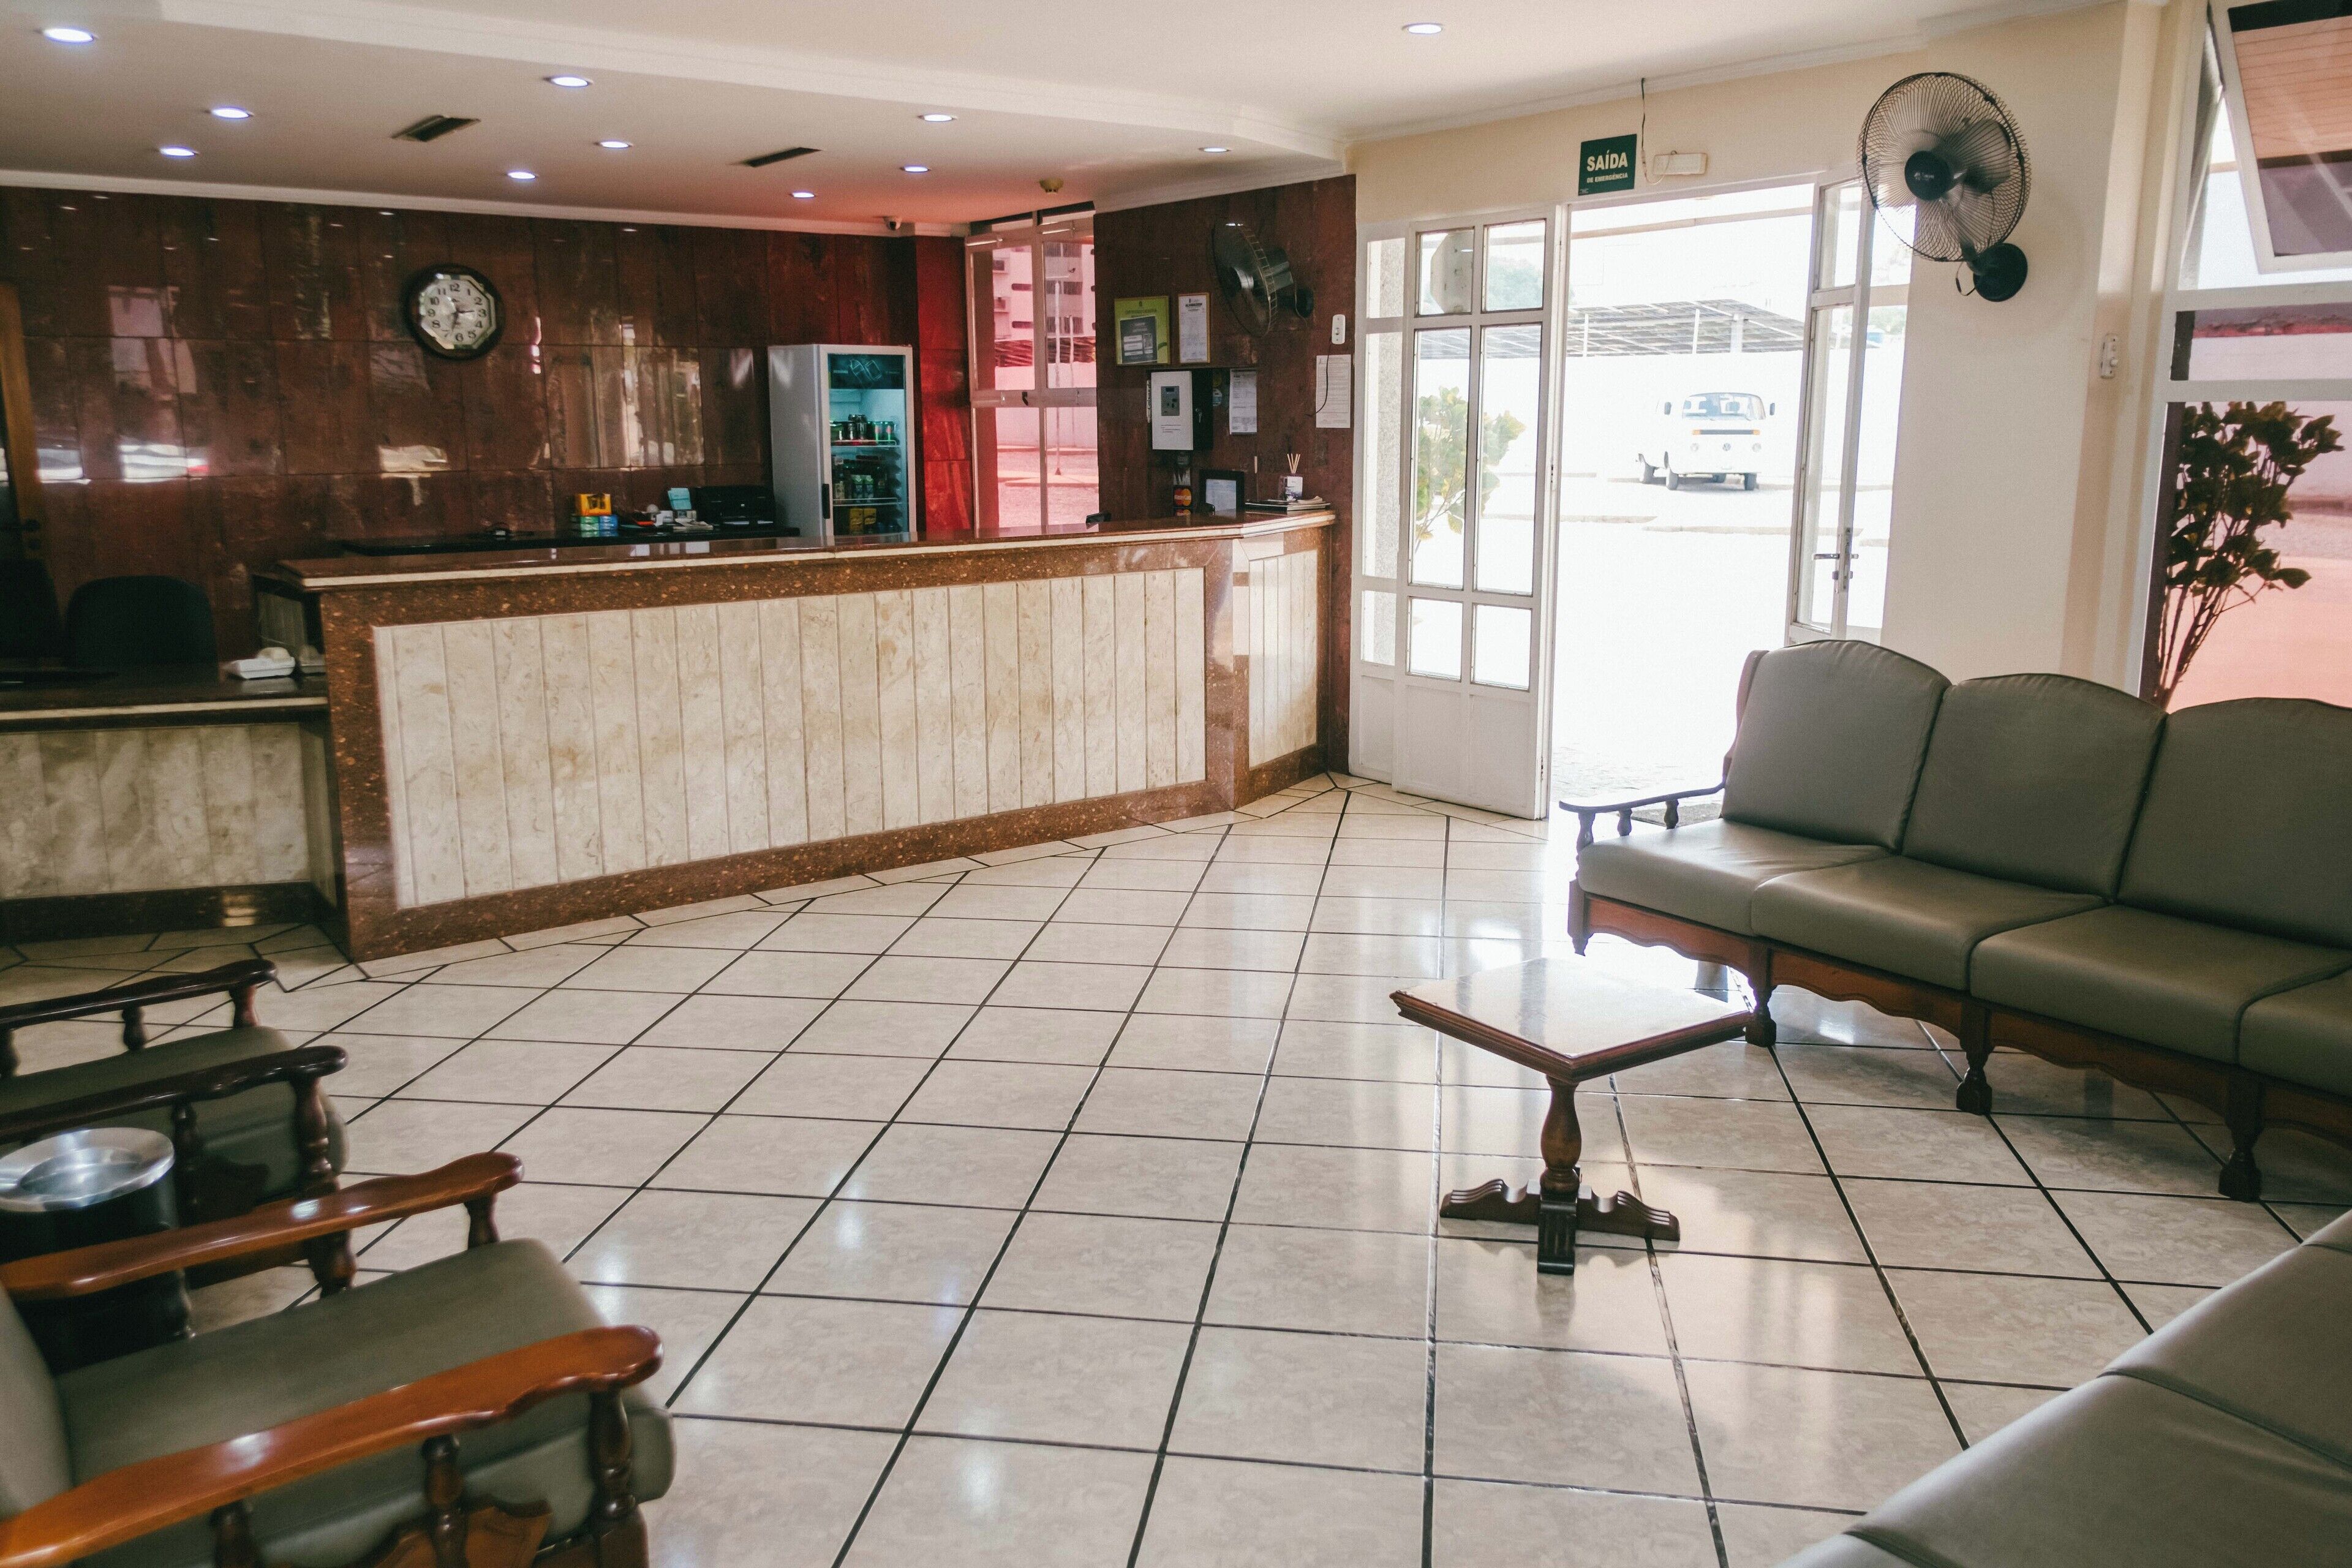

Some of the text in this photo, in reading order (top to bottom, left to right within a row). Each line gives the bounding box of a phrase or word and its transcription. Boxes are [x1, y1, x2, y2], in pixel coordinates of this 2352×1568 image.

[1586, 149, 1628, 172] SAÍDA
[450, 283, 461, 292] 12
[428, 309, 435, 317] 9
[478, 309, 486, 317] 3
[432, 320, 440, 328] 8
[475, 320, 483, 329] 4
[456, 333, 464, 342] 6
[468, 330, 476, 339] 5
